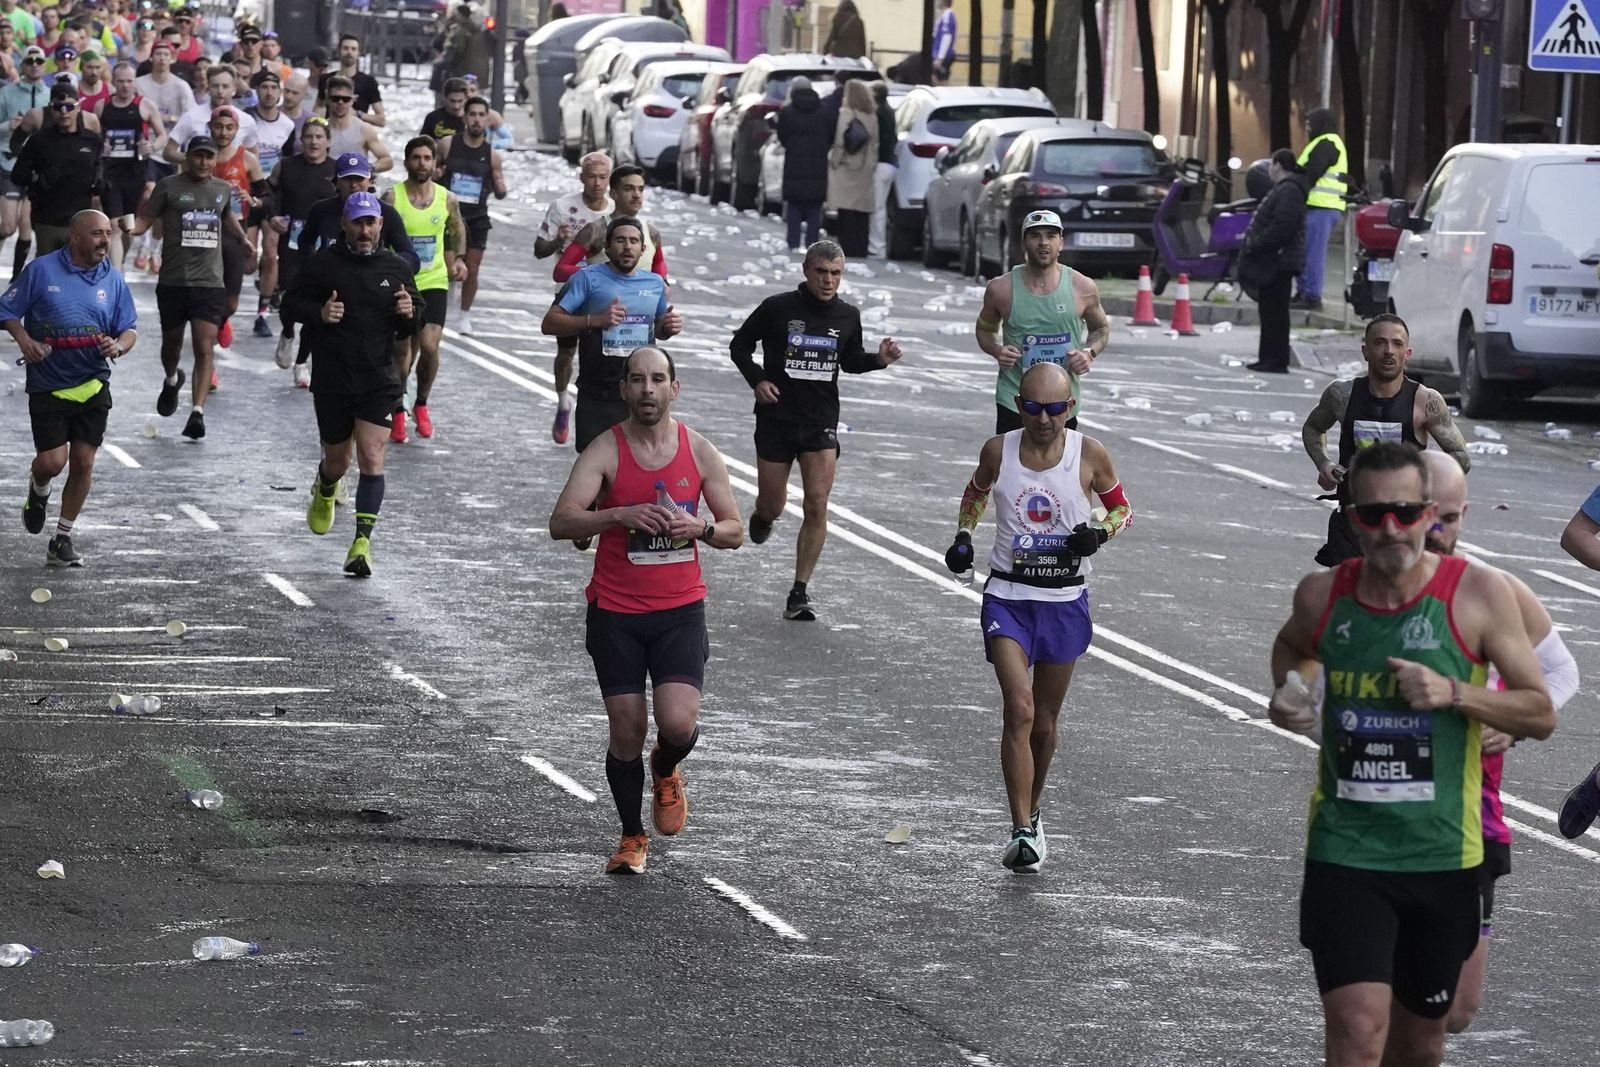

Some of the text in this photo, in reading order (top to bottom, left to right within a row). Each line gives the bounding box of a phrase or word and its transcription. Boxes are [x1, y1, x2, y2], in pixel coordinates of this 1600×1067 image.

[182, 230, 218, 240] MUSTAPHA
[1539, 298, 1572, 311] 9177
[805, 338, 832, 347] ZURICH
[1040, 336, 1066, 344] ZURICH
[804, 351, 818, 359] 5144
[785, 359, 807, 370] PEPE
[1037, 538, 1068, 547] ZURIC
[1037, 555, 1057, 565] 3569
[1363, 716, 1420, 729] ZURICH
[1352, 760, 1413, 780] ANGEL
